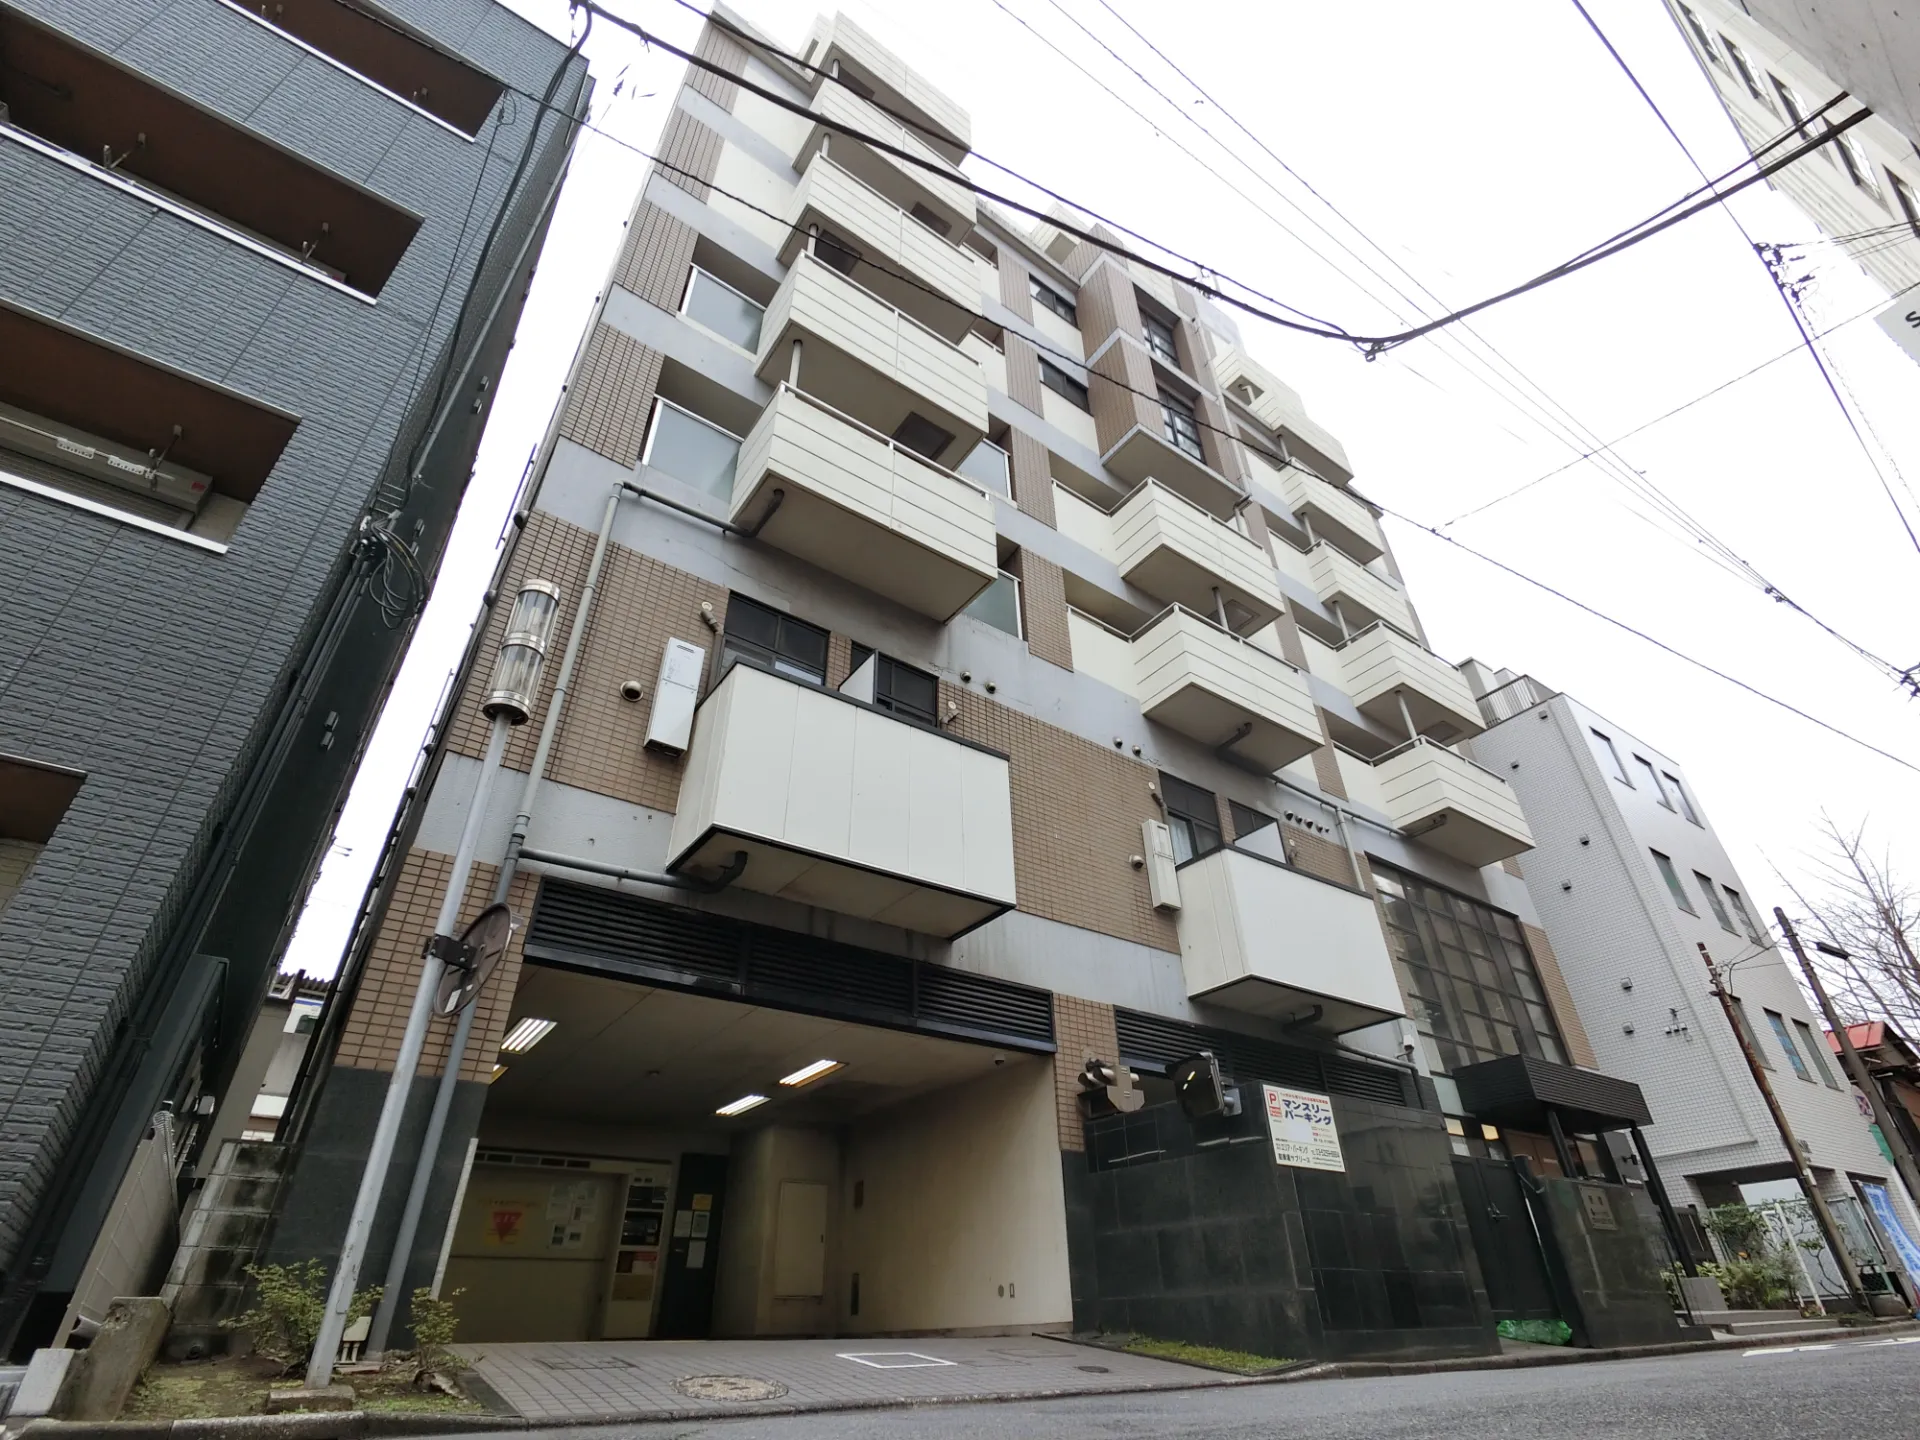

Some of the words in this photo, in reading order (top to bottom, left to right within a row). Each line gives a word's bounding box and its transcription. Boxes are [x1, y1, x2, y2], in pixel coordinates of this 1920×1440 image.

[1269, 1093, 1277, 1105] P
[1282, 1098, 1330, 1114] マンスリー
[1284, 1110, 1332, 1126] パーキング
